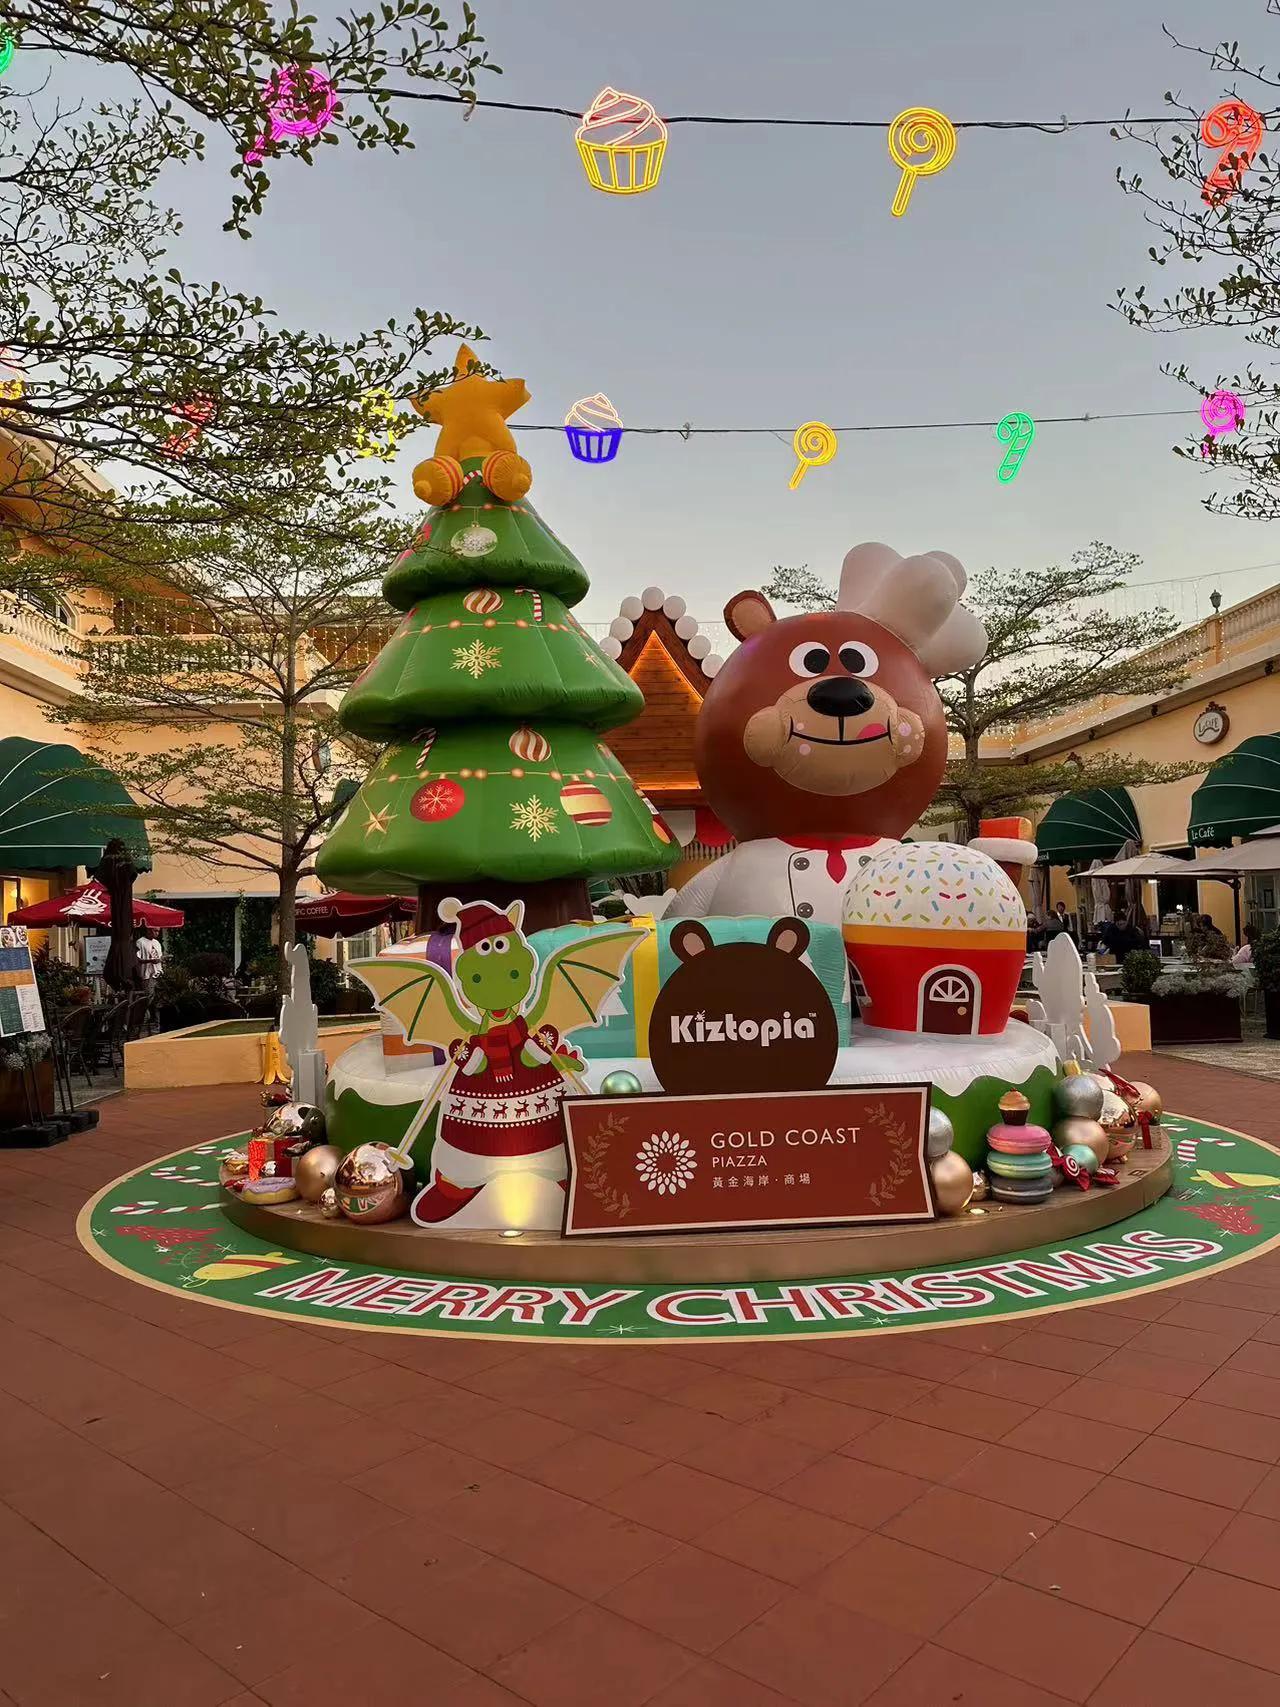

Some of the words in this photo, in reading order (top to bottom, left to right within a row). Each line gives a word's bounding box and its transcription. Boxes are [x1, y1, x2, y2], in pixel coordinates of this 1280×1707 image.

[1199, 826, 1215, 839] Café
[306, 906, 329, 915] COFFEE
[710, 1130, 775, 1149] GOLD
[785, 1127, 861, 1146] COAST
[712, 1155, 768, 1168] PIAZZA
[254, 1268, 643, 1326] MERRY
[646, 1230, 1223, 1324] CHRISTMAS
